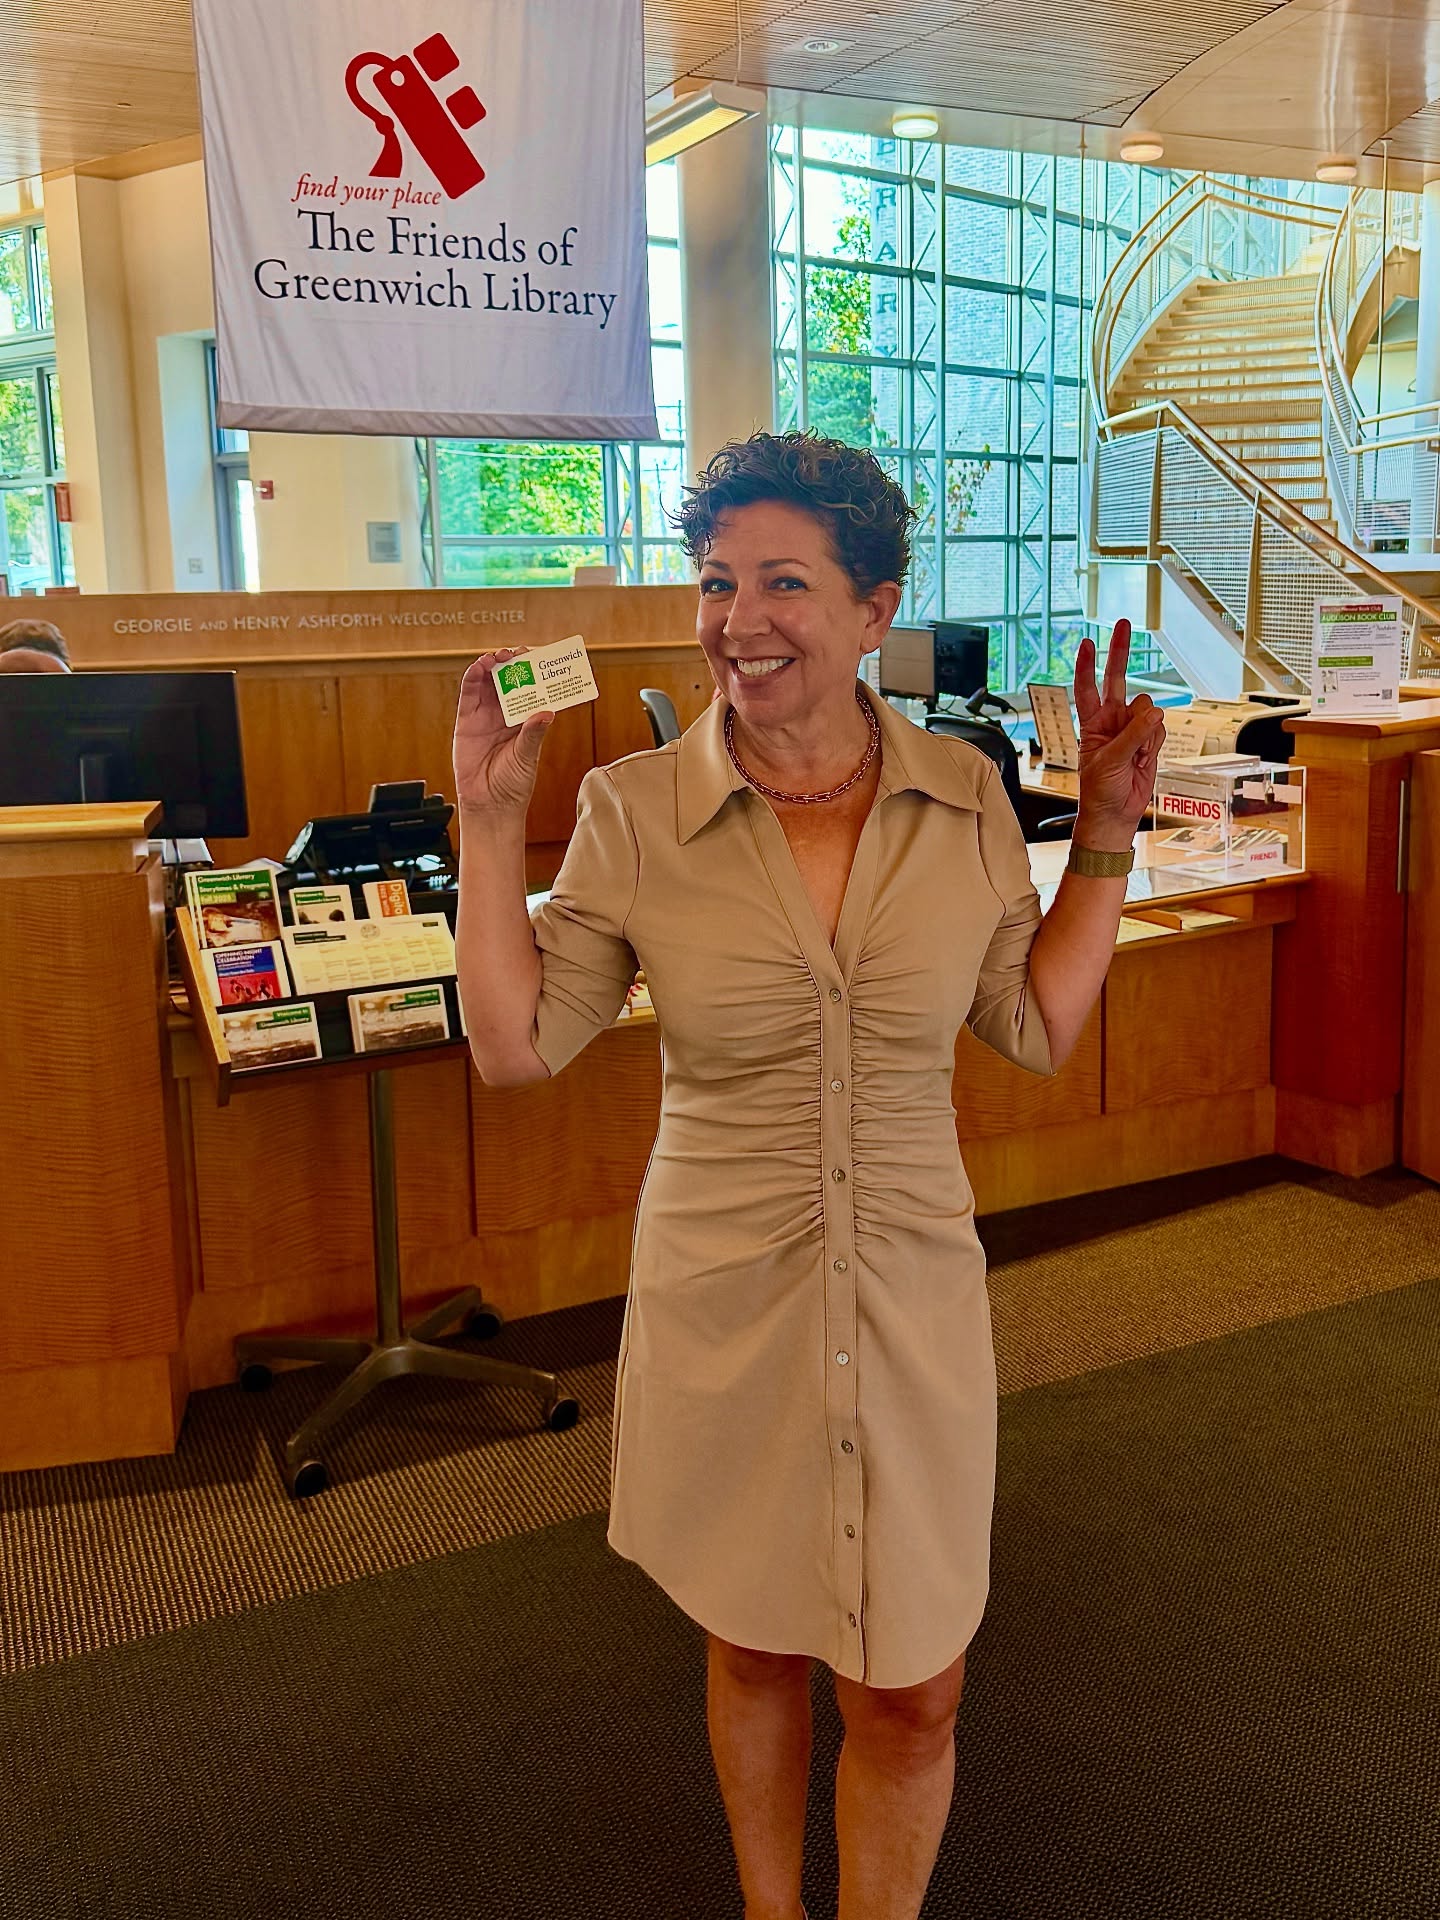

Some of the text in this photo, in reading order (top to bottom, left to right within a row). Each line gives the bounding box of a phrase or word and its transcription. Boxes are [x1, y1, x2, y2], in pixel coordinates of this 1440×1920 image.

[291, 173, 442, 209] find your place
[297, 208, 578, 266] The Friends of
[254, 259, 618, 330] Greenwich Library
[114, 610, 526, 634] GEORGIE AND HENRY ASHFORTH WELCOME CENTER
[1358, 612, 1377, 620] BOOK
[1379, 612, 1396, 620] CLUB
[538, 649, 583, 670] Greenwich
[541, 665, 572, 680] Library
[1163, 797, 1221, 820] FRIENDS
[1250, 850, 1278, 862] FRIENDS
